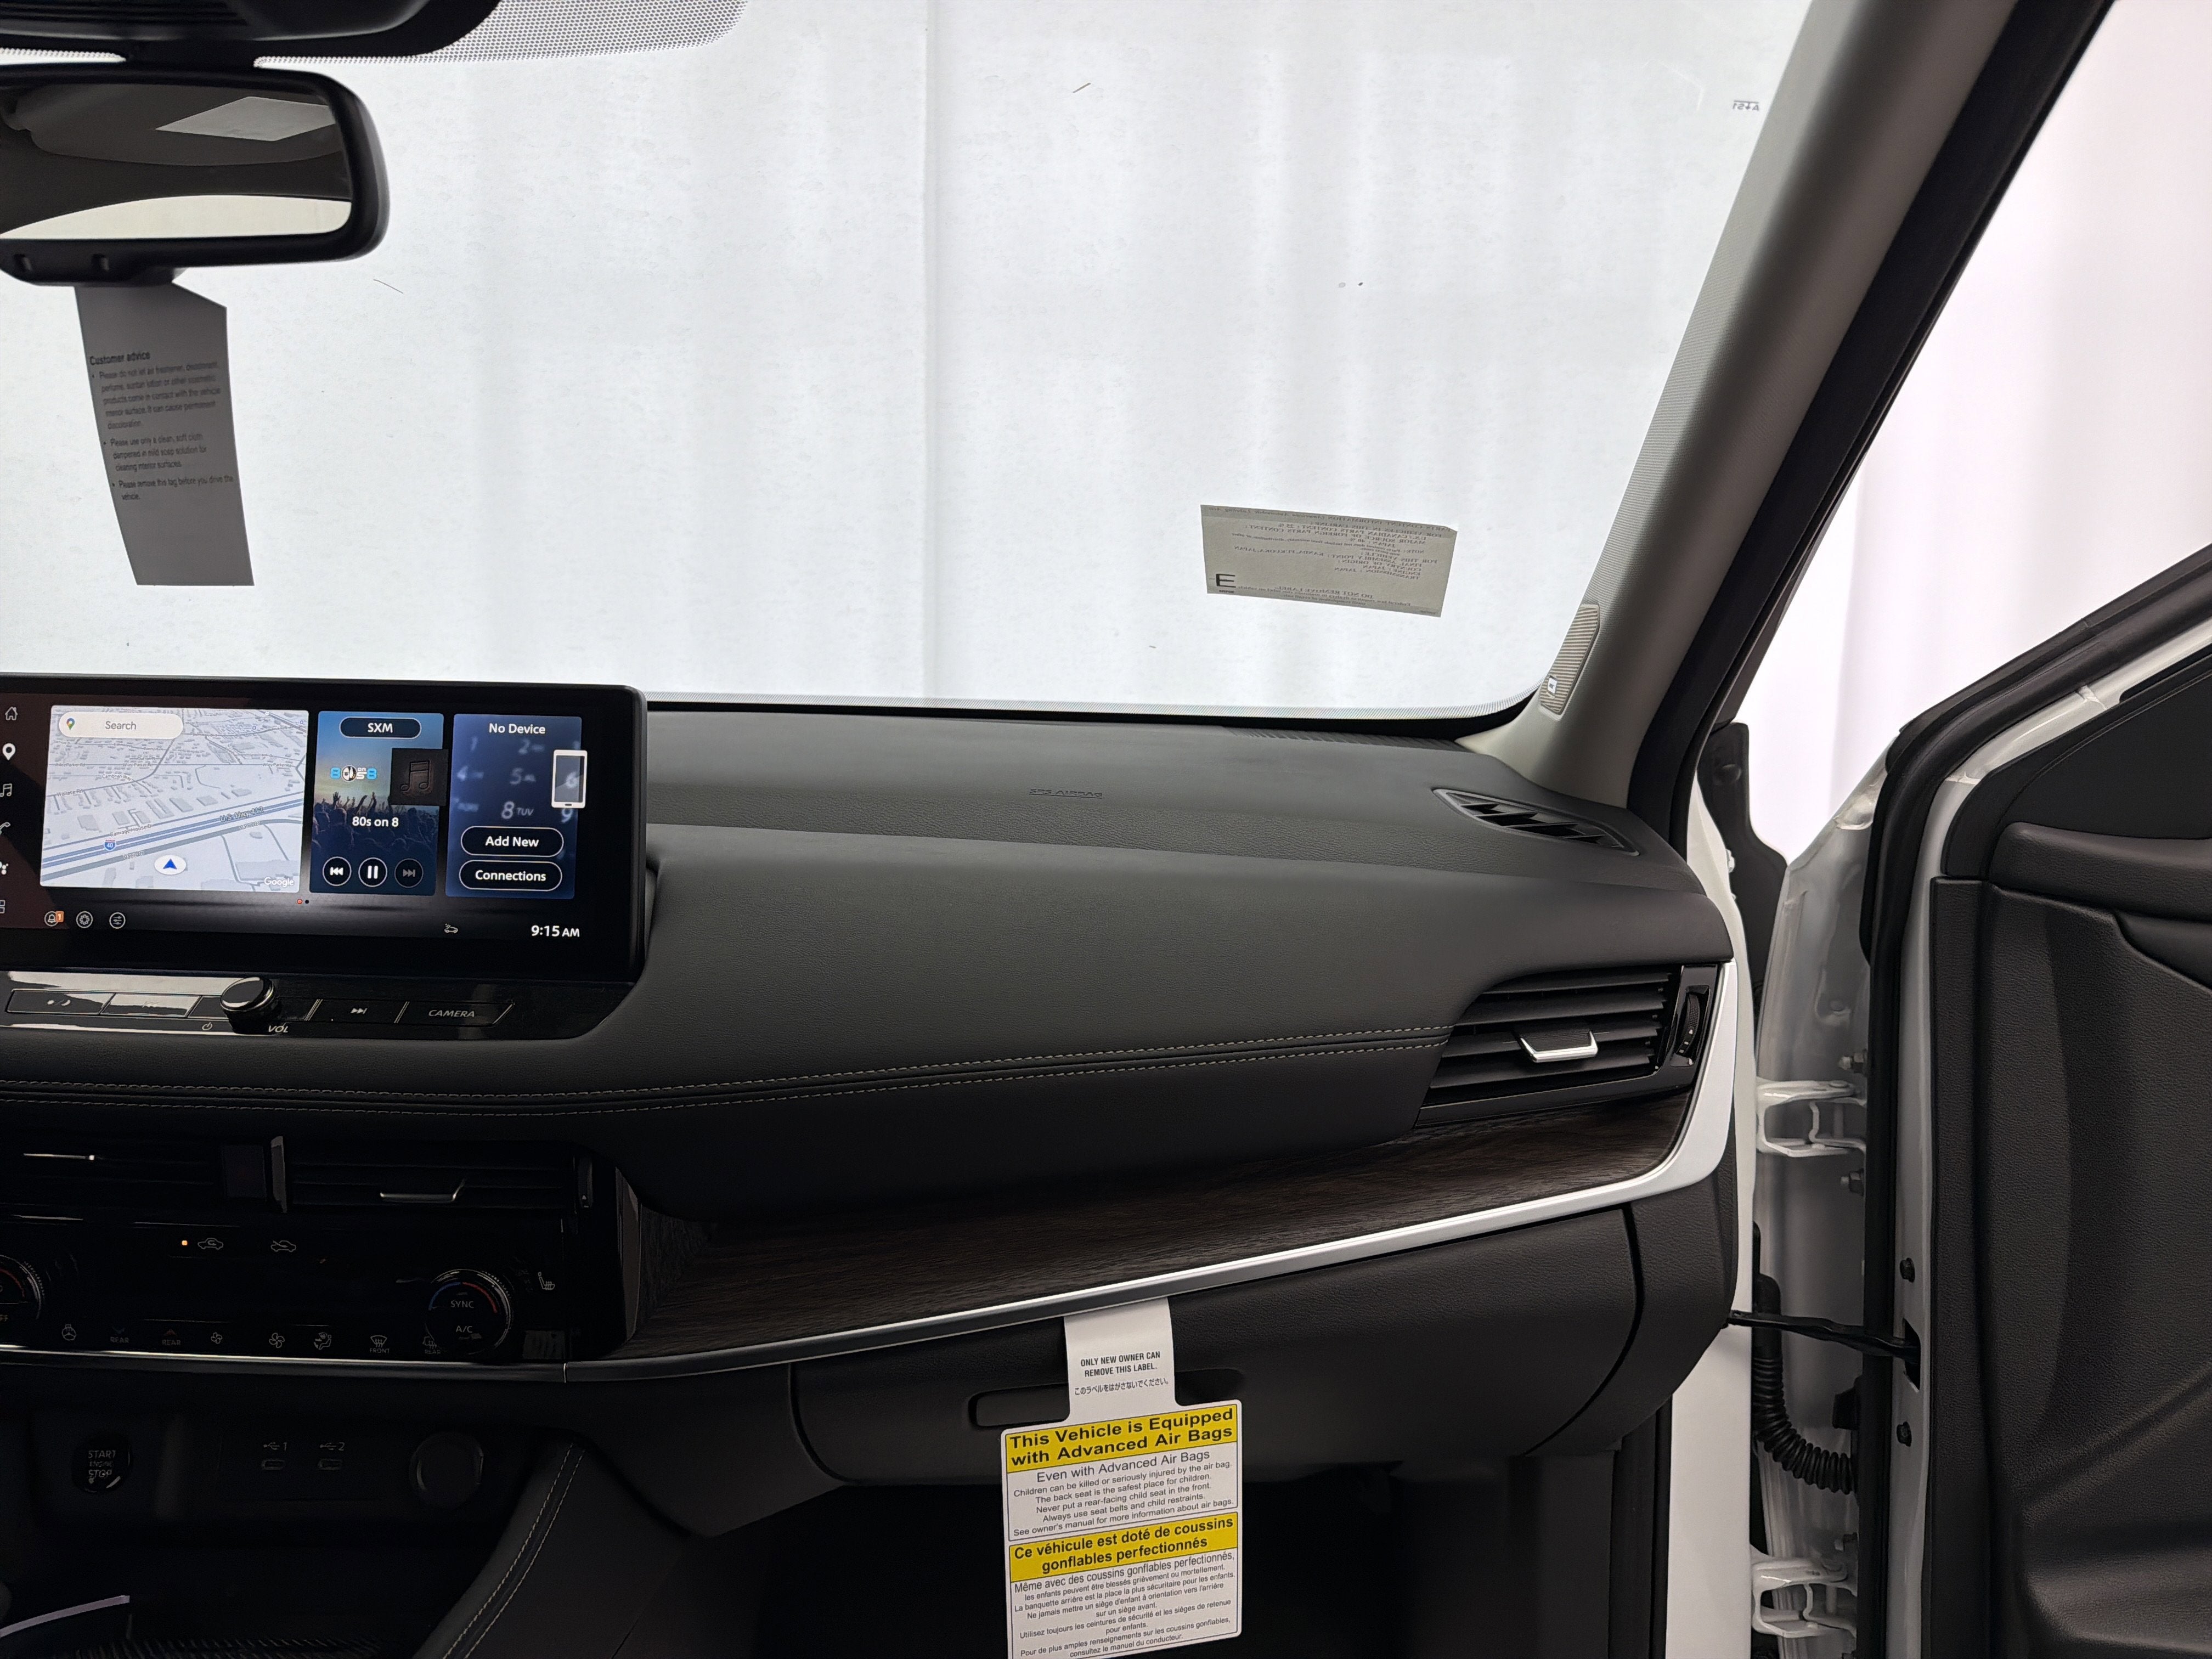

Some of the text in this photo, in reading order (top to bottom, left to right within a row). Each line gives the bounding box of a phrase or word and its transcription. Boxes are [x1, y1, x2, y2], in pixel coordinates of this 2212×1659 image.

[89, 351, 150, 365] Customer advice
[1216, 573, 1236, 588] E
[105, 721, 137, 730] Search
[368, 723, 393, 733] SXM
[489, 723, 546, 734] No Device
[251, 806, 264, 815] 412
[501, 801, 533, 819] 8 TUV
[352, 816, 371, 826] 80s
[392, 817, 399, 827] 8
[486, 836, 539, 847] Add New
[264, 877, 294, 887] Google
[475, 870, 546, 881] Connections
[531, 925, 580, 937] 9:15 AM
[428, 1009, 475, 1018] CAMERA
[450, 1300, 475, 1308] SYNC
[1080, 1350, 1160, 1367] ONLY NEW OWNER CAN
[1084, 1366, 1114, 1377] REMOVE
[1114, 1364, 1132, 1374] THIS
[1009, 1407, 1233, 1448] This Vehicle is Equipped
[283, 1442, 287, 1451] 1
[338, 1442, 345, 1451] 2
[1011, 1427, 1232, 1466] with Advanced Air Bags
[88, 1450, 116, 1458] START
[88, 1469, 112, 1478] STOP
[1036, 1451, 1210, 1482] Even with Advanced Air Bags
[1013, 1487, 1047, 1497] Children
[1066, 1482, 1076, 1490] be
[1079, 1477, 1099, 1488] killed
[1111, 1472, 1147, 1483] seriously
[1148, 1467, 1175, 1479] injured
[1177, 1466, 1187, 1475] by
[1188, 1464, 1201, 1472] the
[1203, 1462, 1214, 1470] air
[1035, 1496, 1051, 1504] The
[1053, 1492, 1073, 1502] back
[1074, 1489, 1092, 1498] seat
[1102, 1486, 1115, 1494] the
[1117, 1482, 1142, 1492] safest
[1143, 1480, 1165, 1491] place
[1178, 1474, 1211, 1483] children.
[1036, 1504, 1060, 1514] Never
[1062, 1501, 1075, 1512] put
[1084, 1495, 1127, 1506] rear-facing
[1128, 1490, 1147, 1500] child
[1149, 1488, 1166, 1497] seat
[1177, 1485, 1190, 1493] the
[1191, 1481, 1211, 1491] front.
[1042, 1513, 1071, 1522] Always
[1090, 1506, 1107, 1516] seat
[1109, 1504, 1128, 1513] belts
[1130, 1500, 1145, 1510] and
[1147, 1497, 1165, 1507] child
[1167, 1493, 1205, 1504] restraints.
[1031, 1522, 1063, 1534] owner's
[1064, 1517, 1094, 1529] manual
[1109, 1514, 1129, 1522] more
[1131, 1507, 1175, 1519] information
[1176, 1502, 1199, 1513] about
[1200, 1500, 1211, 1509] air
[1212, 1499, 1233, 1507] bags.
[1014, 1517, 1233, 1559] Ce véhicule est doté de coussins
[1042, 1536, 1207, 1575] gonflables perfectionnés
[1014, 1581, 1042, 1593] Même
[1044, 1577, 1066, 1589] avec
[1068, 1574, 1084, 1585] des
[1086, 1568, 1125, 1582] coussins
[1126, 1561, 1171, 1578] gonflables
[1036, 1589, 1061, 1599] enfants
[1062, 1584, 1090, 1596] peuvent
[1105, 1578, 1131, 1588] blessés
[1132, 1571, 1169, 1585] grièvement
[1180, 1563, 1225, 1577] mortellement.
[1118, 1605, 1136, 1615] siège
[1137, 1601, 1157, 1611] avant.
